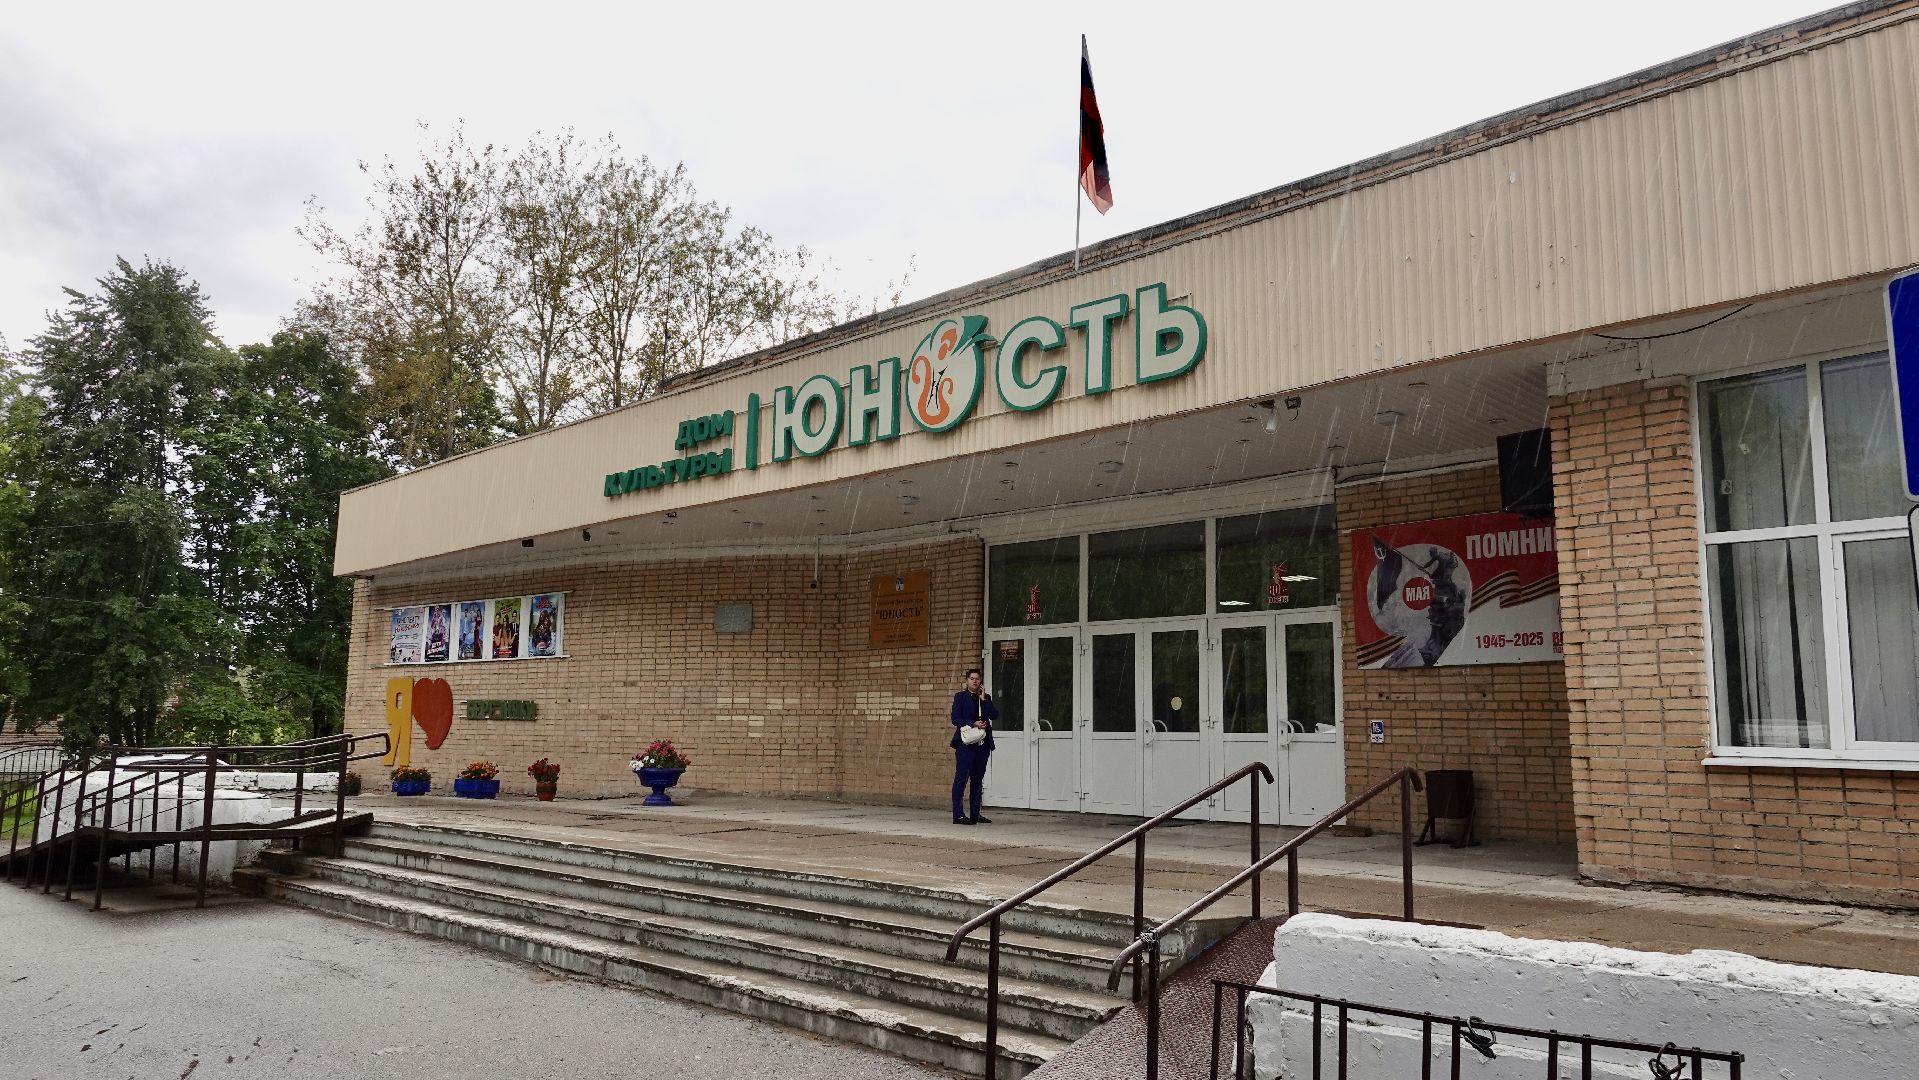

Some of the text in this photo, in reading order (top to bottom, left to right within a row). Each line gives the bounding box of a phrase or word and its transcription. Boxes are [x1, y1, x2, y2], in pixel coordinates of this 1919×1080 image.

[773, 282, 1207, 462] ЮНОСТЬ
[675, 410, 734, 450] ДОМ
[604, 448, 732, 497] КУЛЬТУРЫ
[1406, 585, 1430, 602] МАЯ
[1475, 631, 1544, 649] 1945-2025
[384, 676, 414, 767] Я
